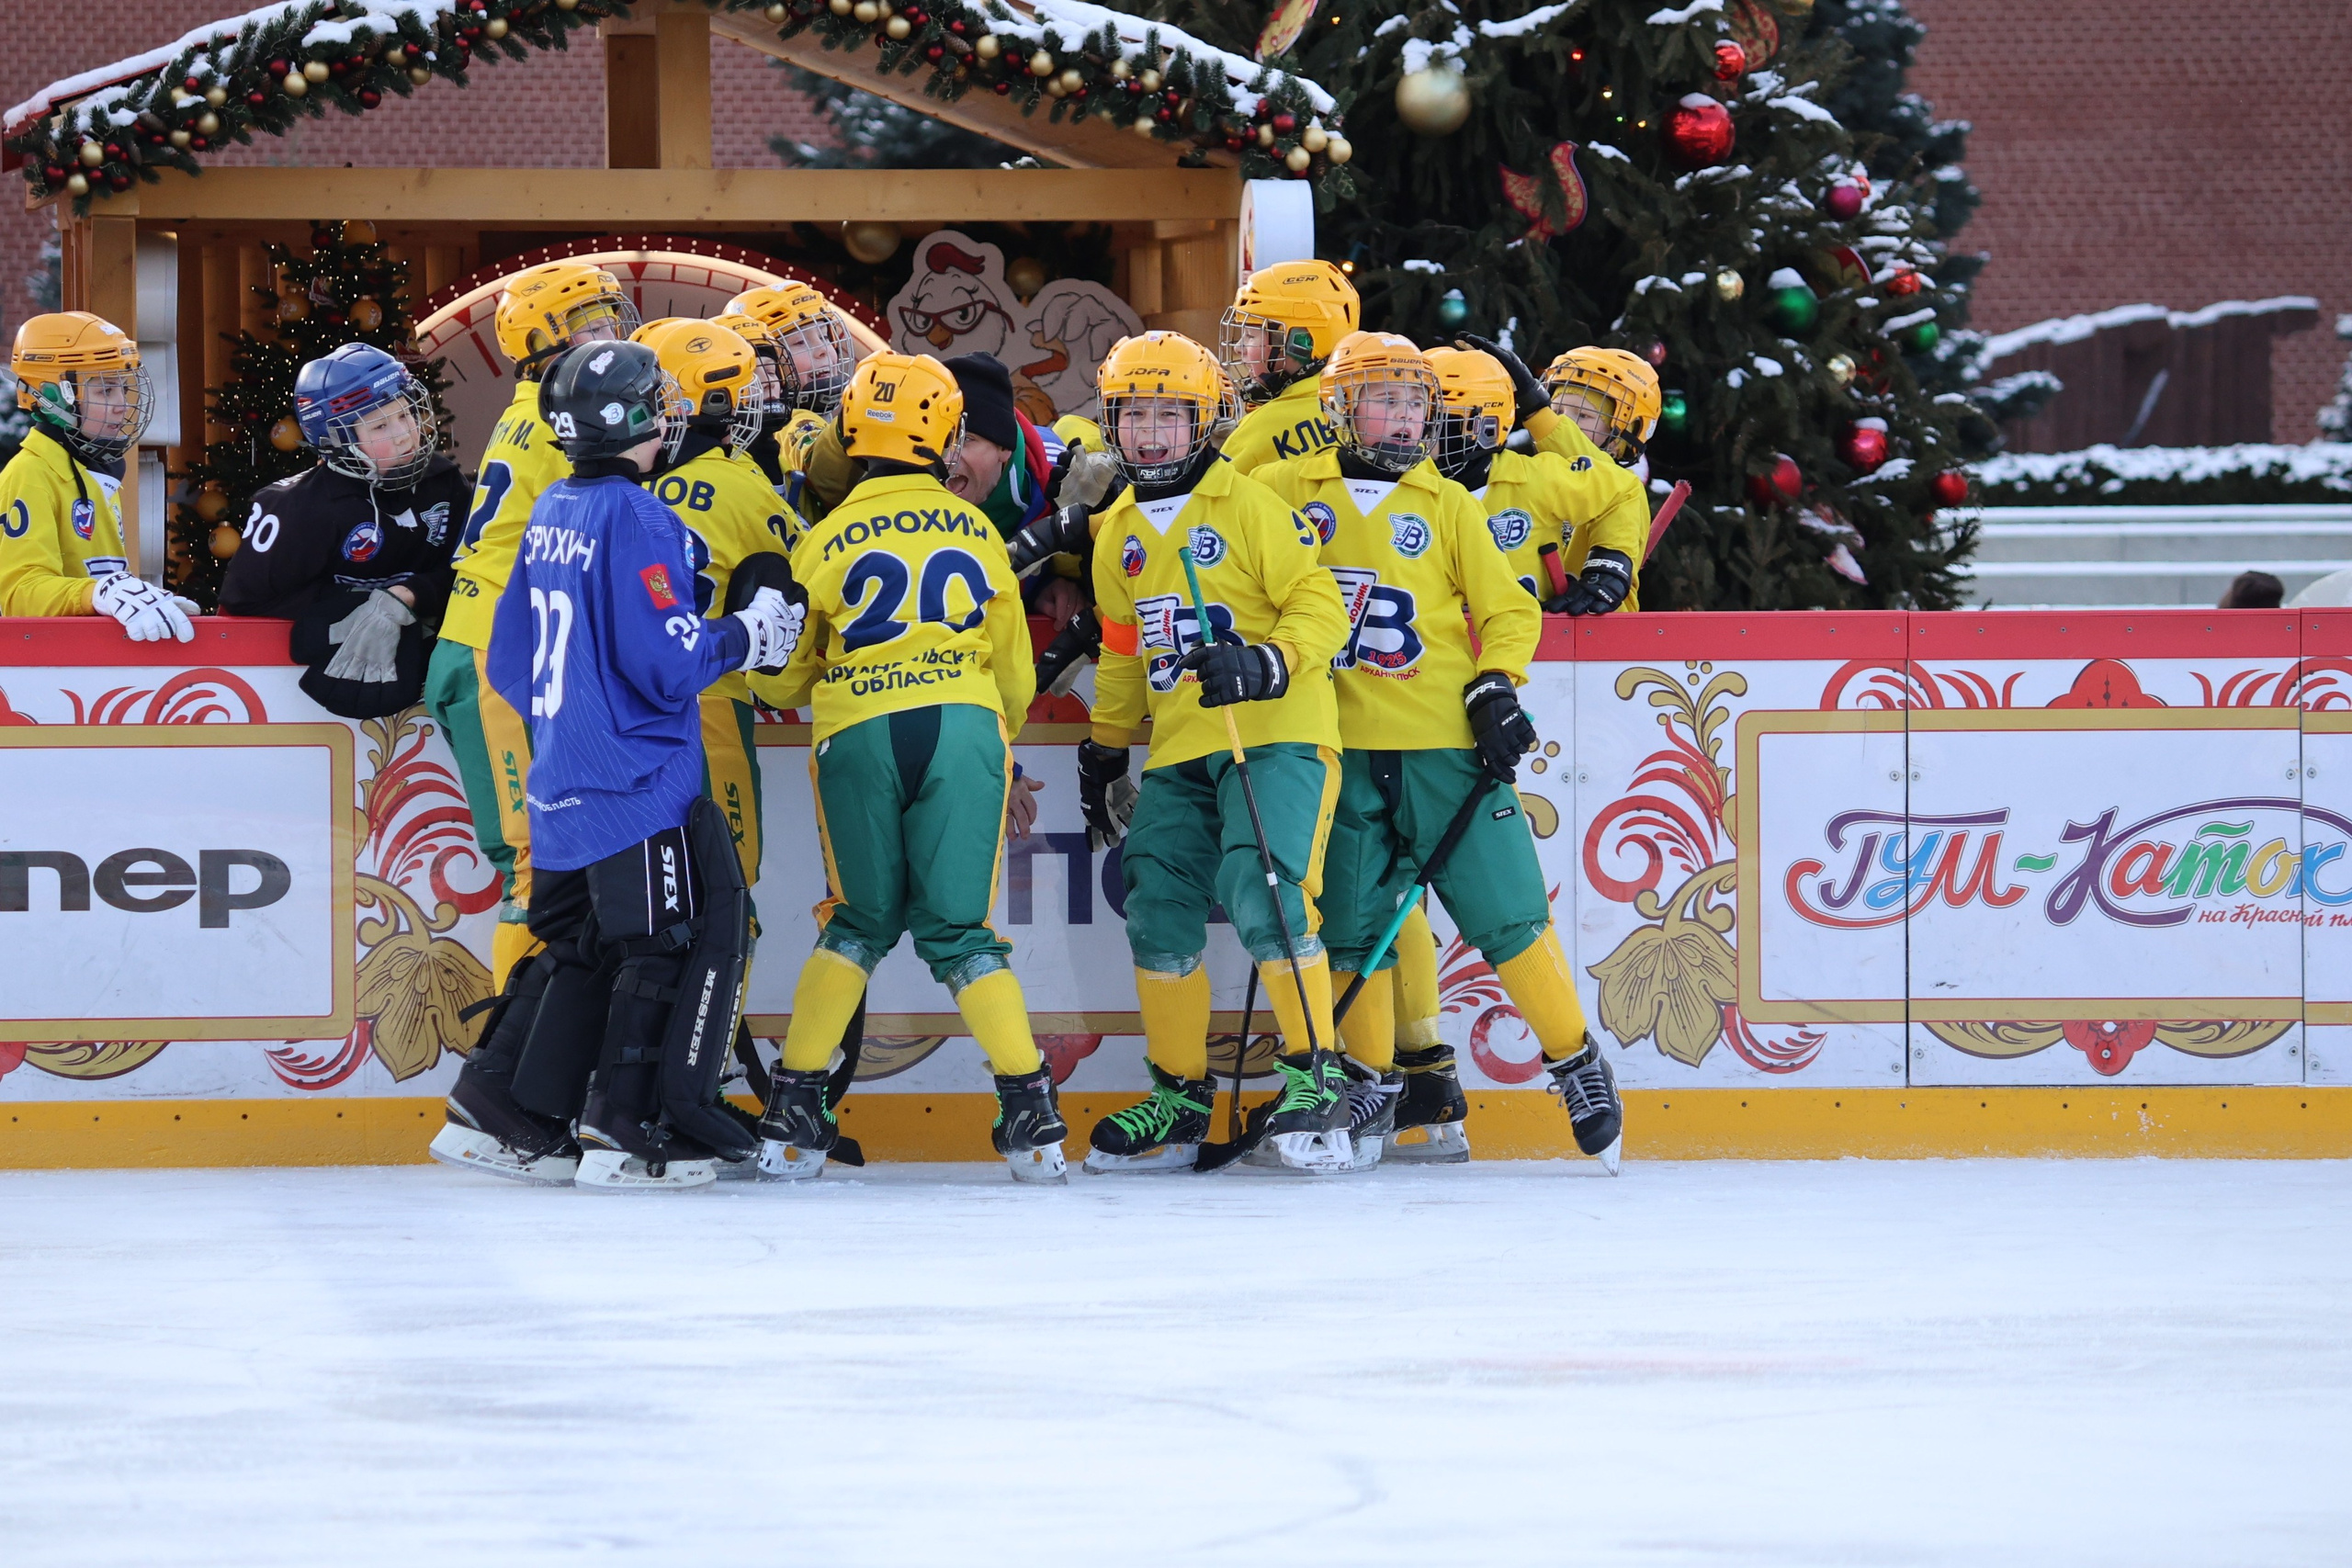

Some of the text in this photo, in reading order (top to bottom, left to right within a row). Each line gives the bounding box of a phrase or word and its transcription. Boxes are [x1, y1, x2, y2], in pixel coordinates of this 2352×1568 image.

[792, 294, 817, 306] CCM
[732, 322, 759, 331] CCM
[373, 371, 401, 389] BAUER
[1125, 368, 1170, 377] JOFA
[874, 381, 896, 402] 20
[301, 410, 322, 421] BAUER
[866, 409, 893, 420] Reebok
[549, 412, 578, 438] 29
[642, 475, 716, 512] ОВ
[1150, 505, 1175, 514] STEX
[840, 547, 997, 654] 20
[1598, 588, 1615, 604] STEX
[1368, 651, 1408, 668] 1925
[851, 669, 963, 696] ОБЛАСТЬ
[1500, 712, 1519, 727] STEX
[501, 749, 526, 817] STEX
[724, 781, 746, 848] STEX
[1495, 808, 1512, 818] STEX
[661, 844, 680, 913] STEX
[2197, 908, 2228, 923] на
[686, 966, 718, 1068] MESHER
